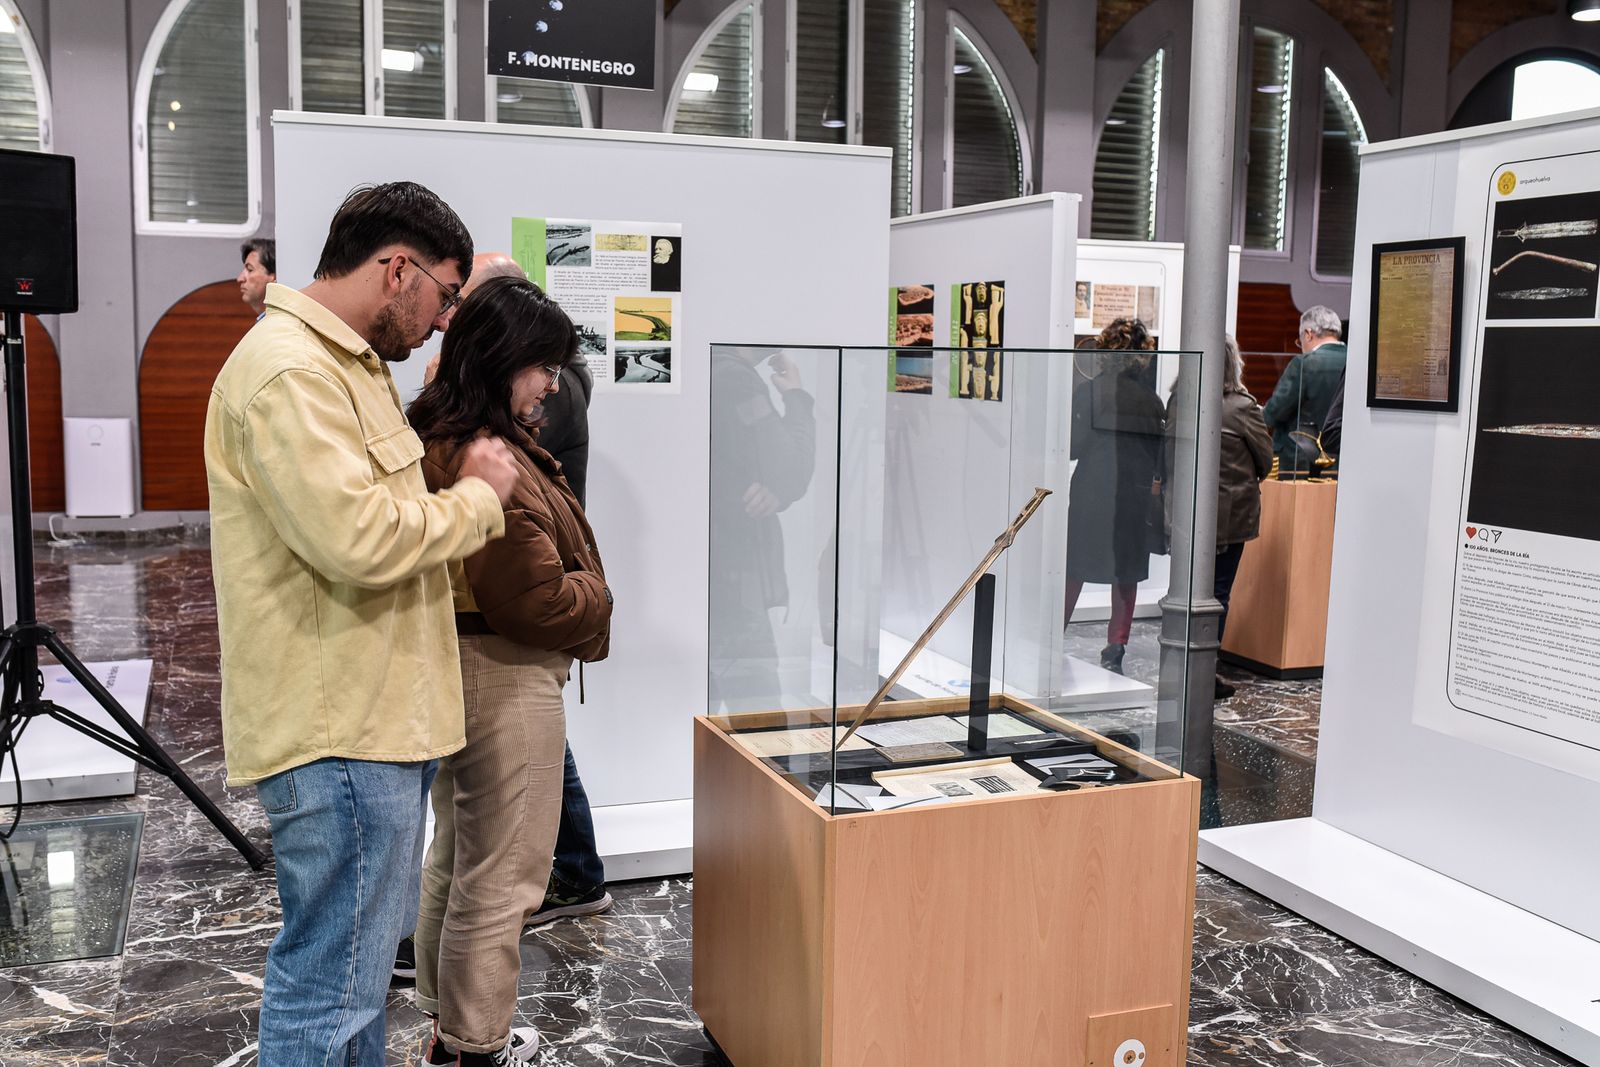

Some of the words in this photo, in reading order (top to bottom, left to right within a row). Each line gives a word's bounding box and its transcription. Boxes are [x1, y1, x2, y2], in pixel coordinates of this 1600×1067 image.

[508, 52, 521, 65] F.
[526, 54, 635, 76] MONTENEGRO
[1393, 256, 1402, 265] LA
[1403, 254, 1440, 265] PROVINCIA
[1489, 548, 1510, 556] BRONCES
